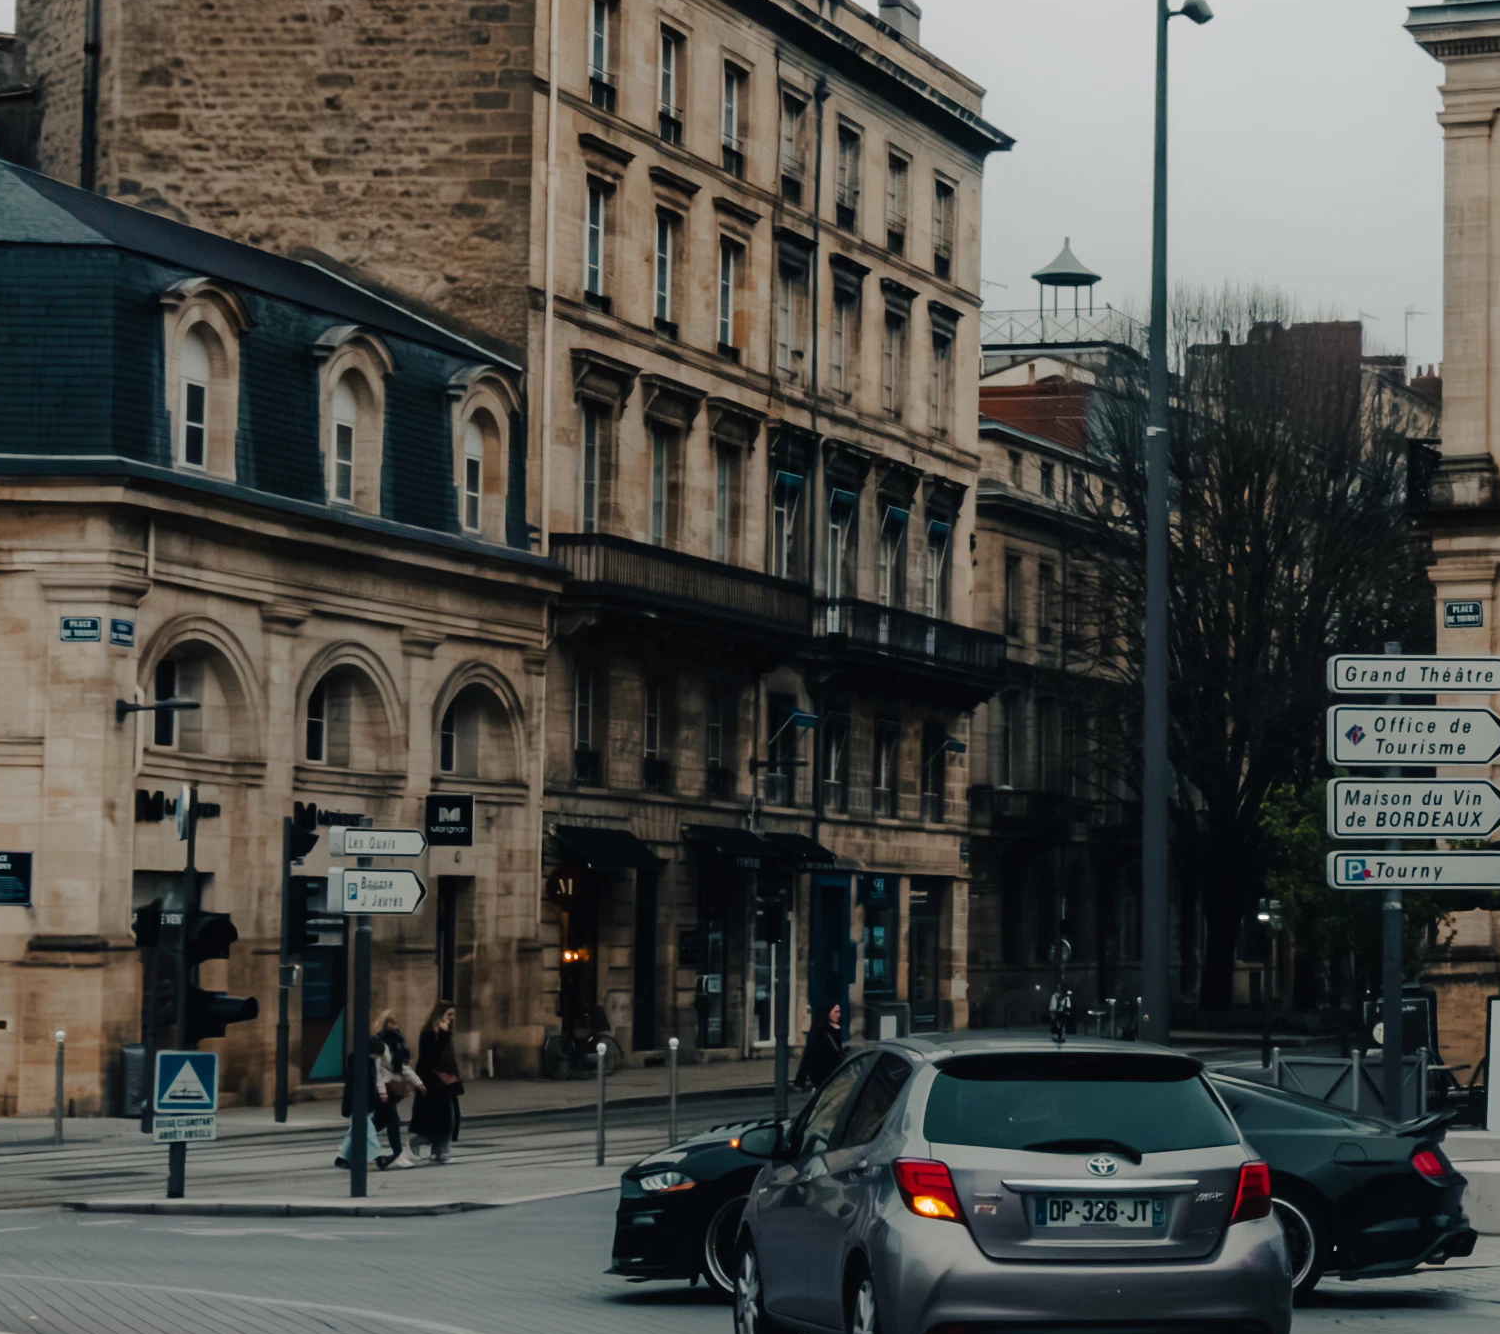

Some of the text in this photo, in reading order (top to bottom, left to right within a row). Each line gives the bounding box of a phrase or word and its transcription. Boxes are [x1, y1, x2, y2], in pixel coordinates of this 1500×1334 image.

[1452, 605, 1474, 613] PLACE
[1345, 665, 1494, 683] Grand Théâtre
[1374, 716, 1472, 733] Office de
[1376, 738, 1467, 756] Tourisme
[1344, 789, 1483, 806] Maison du Vin
[1345, 811, 1484, 828] de BORDEAUX
[430, 826, 468, 835] Marignan
[348, 835, 397, 850] Les Quais
[1376, 861, 1444, 882] Tourny
[360, 876, 394, 891] Bourse
